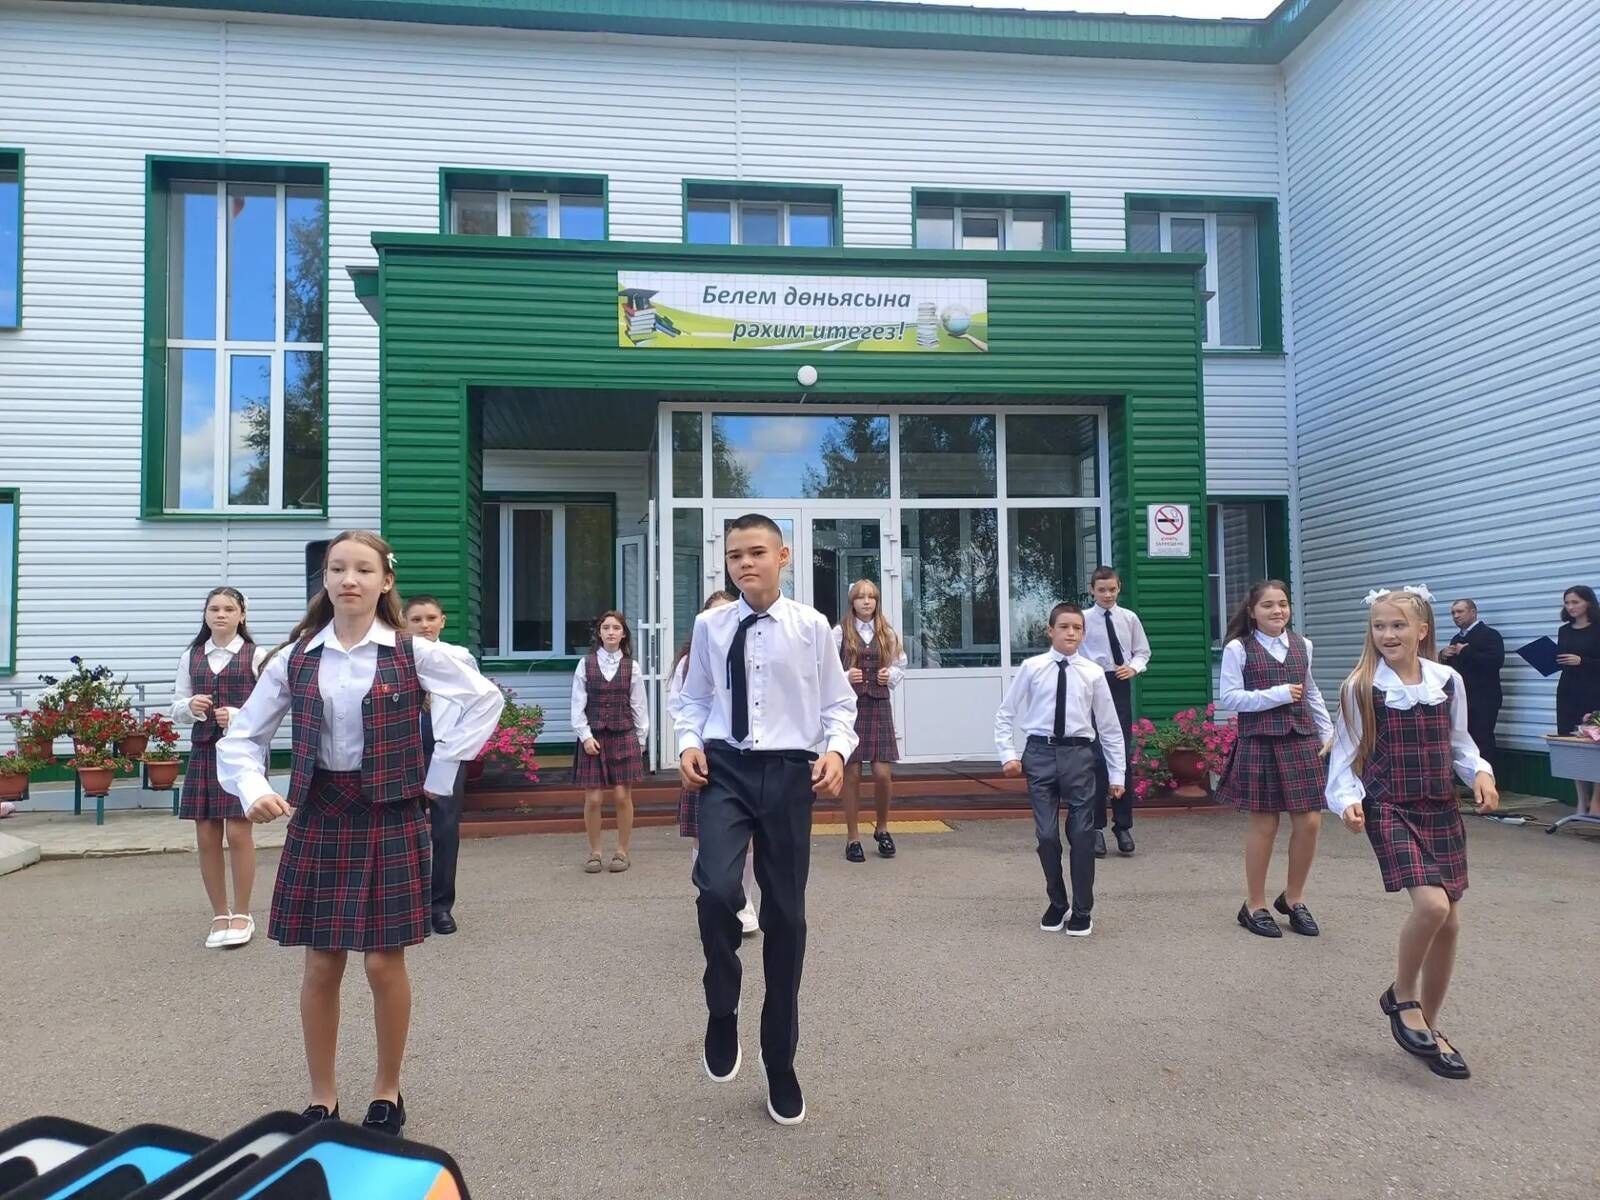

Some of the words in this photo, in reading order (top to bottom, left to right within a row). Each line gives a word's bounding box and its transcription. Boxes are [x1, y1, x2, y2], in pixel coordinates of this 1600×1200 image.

[702, 285, 777, 305] Белем
[784, 286, 911, 308] дөньясына
[732, 321, 806, 342] рәхим
[814, 321, 906, 341] итегез!
